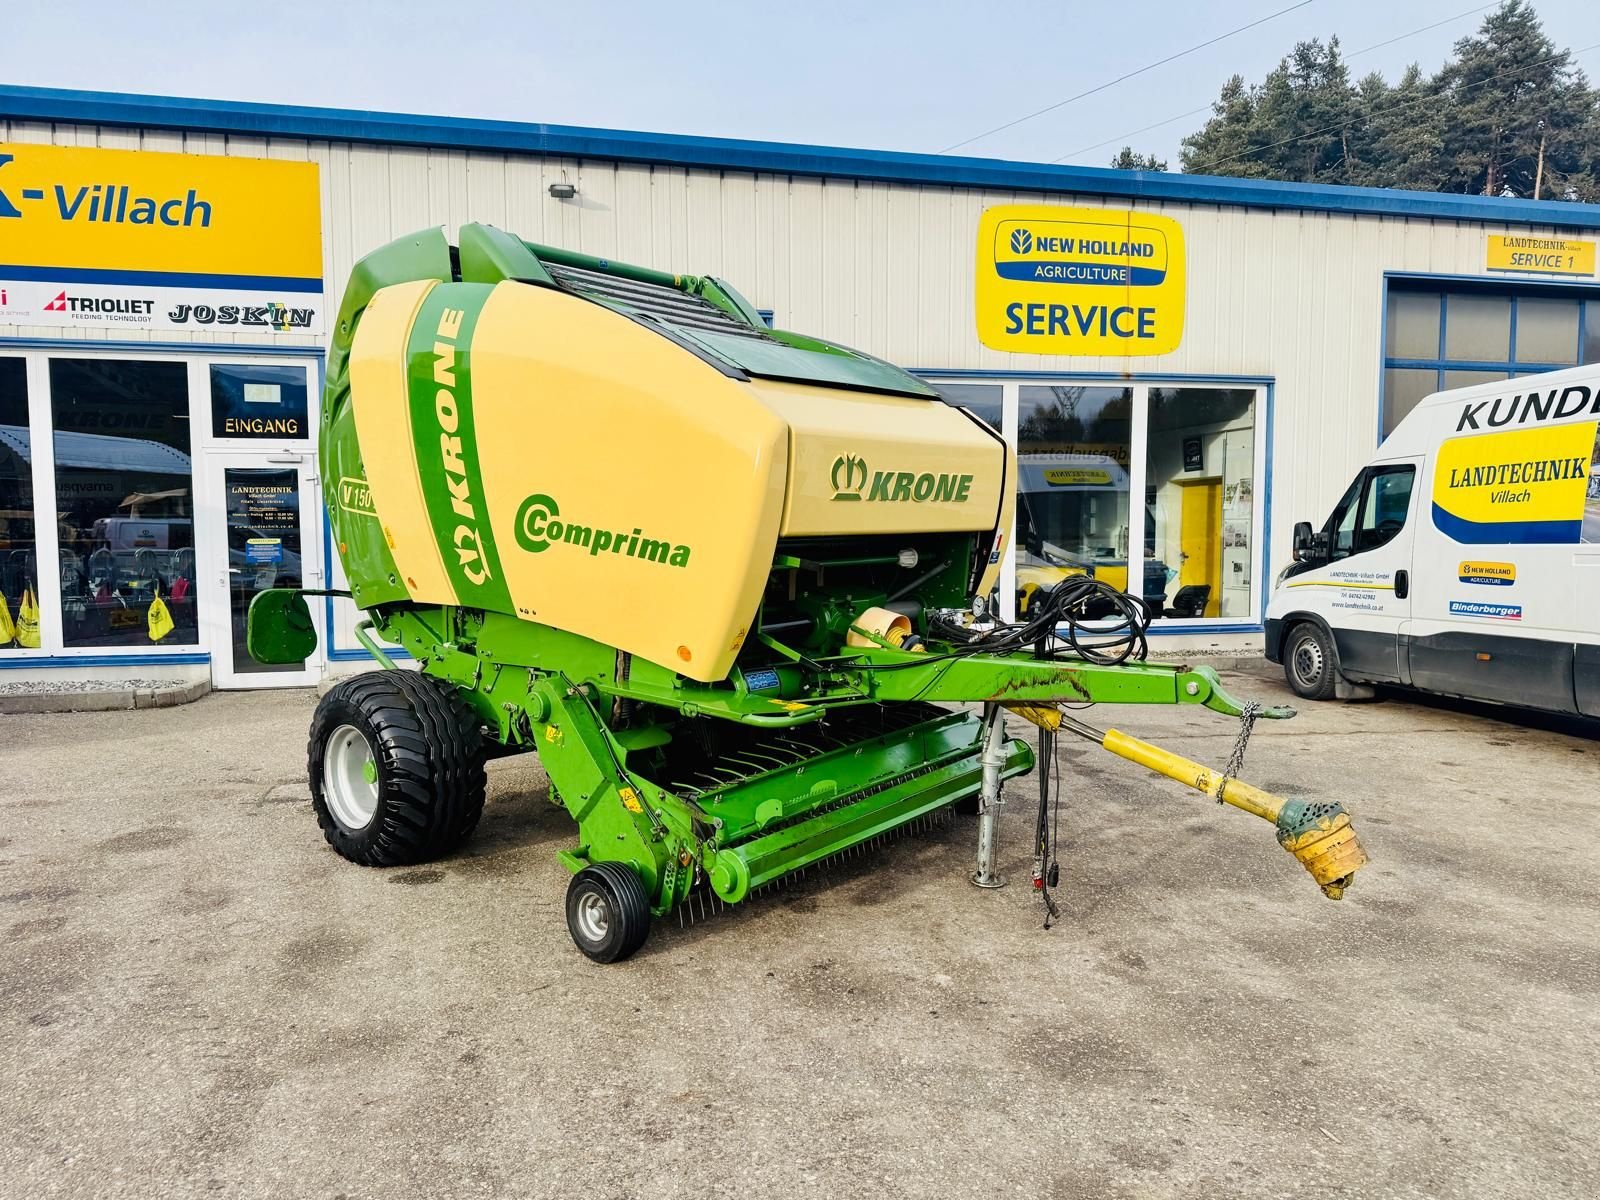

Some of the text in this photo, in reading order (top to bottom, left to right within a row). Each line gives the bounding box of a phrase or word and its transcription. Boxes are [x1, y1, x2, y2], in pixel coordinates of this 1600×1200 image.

[1036, 237, 1154, 258] NEW HOLLAND
[1510, 252, 1574, 269] SERVICE 1
[1034, 265, 1127, 281] AGRICULTURE
[67, 297, 315, 328] TRIOLIET JOSKIN
[71, 313, 152, 324] FEEDING TECHNOLOGY
[1005, 302, 1155, 338] SERVICE
[433, 307, 476, 520] KRONE
[225, 417, 299, 434] EINGANG
[1449, 457, 1587, 488] LANDTECHNIK
[56, 482, 114, 494] usqvarna
[232, 486, 292, 494] LANDTECHNIK
[343, 485, 371, 507] V 150
[866, 471, 974, 502] KRONE
[1490, 489, 1531, 503] Villach
[514, 493, 691, 568] Comprima
[1451, 602, 1520, 615] Binderberger
